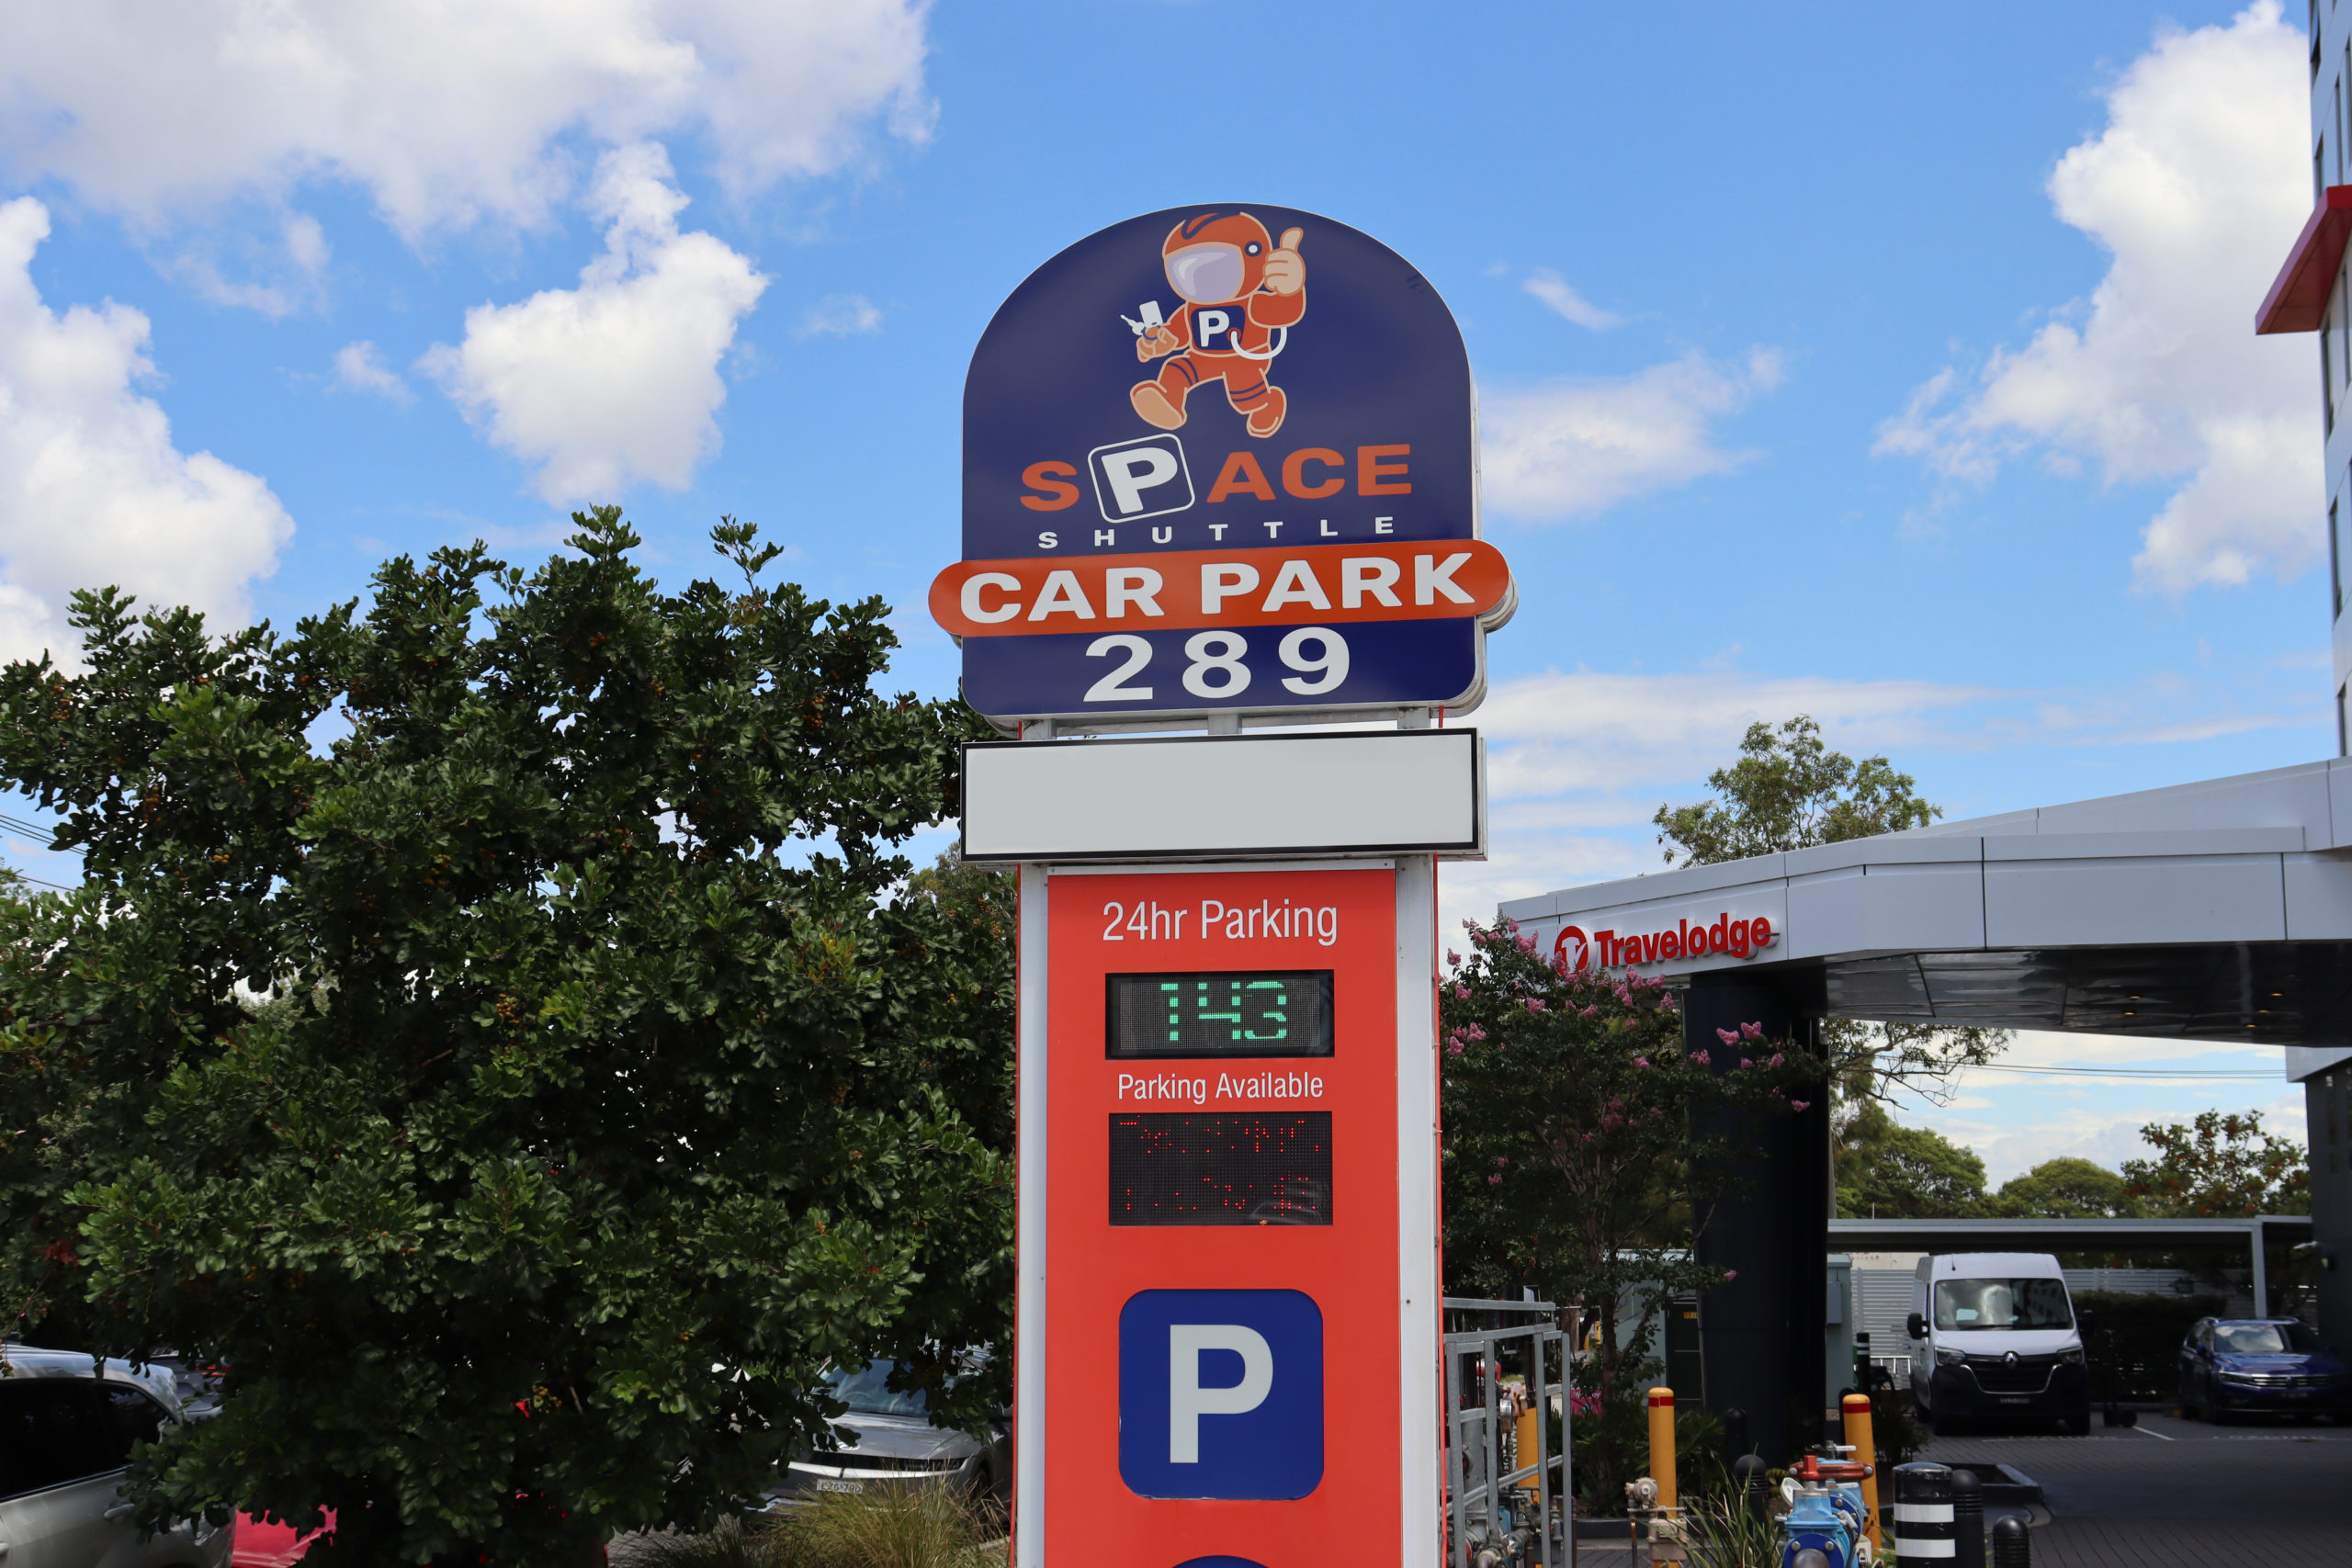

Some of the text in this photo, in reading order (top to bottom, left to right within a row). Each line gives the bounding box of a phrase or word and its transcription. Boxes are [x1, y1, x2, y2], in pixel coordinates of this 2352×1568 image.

[1198, 310, 1229, 347] P
[1020, 444, 1412, 514] SPACE
[1037, 516, 1394, 548] SHUTTLE
[960, 552, 1476, 624] CAR PARK
[1083, 626, 1351, 703] 289
[1102, 898, 1339, 946] 24hr Parking
[1594, 912, 1771, 966] Travelodge
[1160, 981, 1287, 1041] 143
[1117, 1071, 1324, 1104] Parking Available
[1170, 1325, 1273, 1463] P
